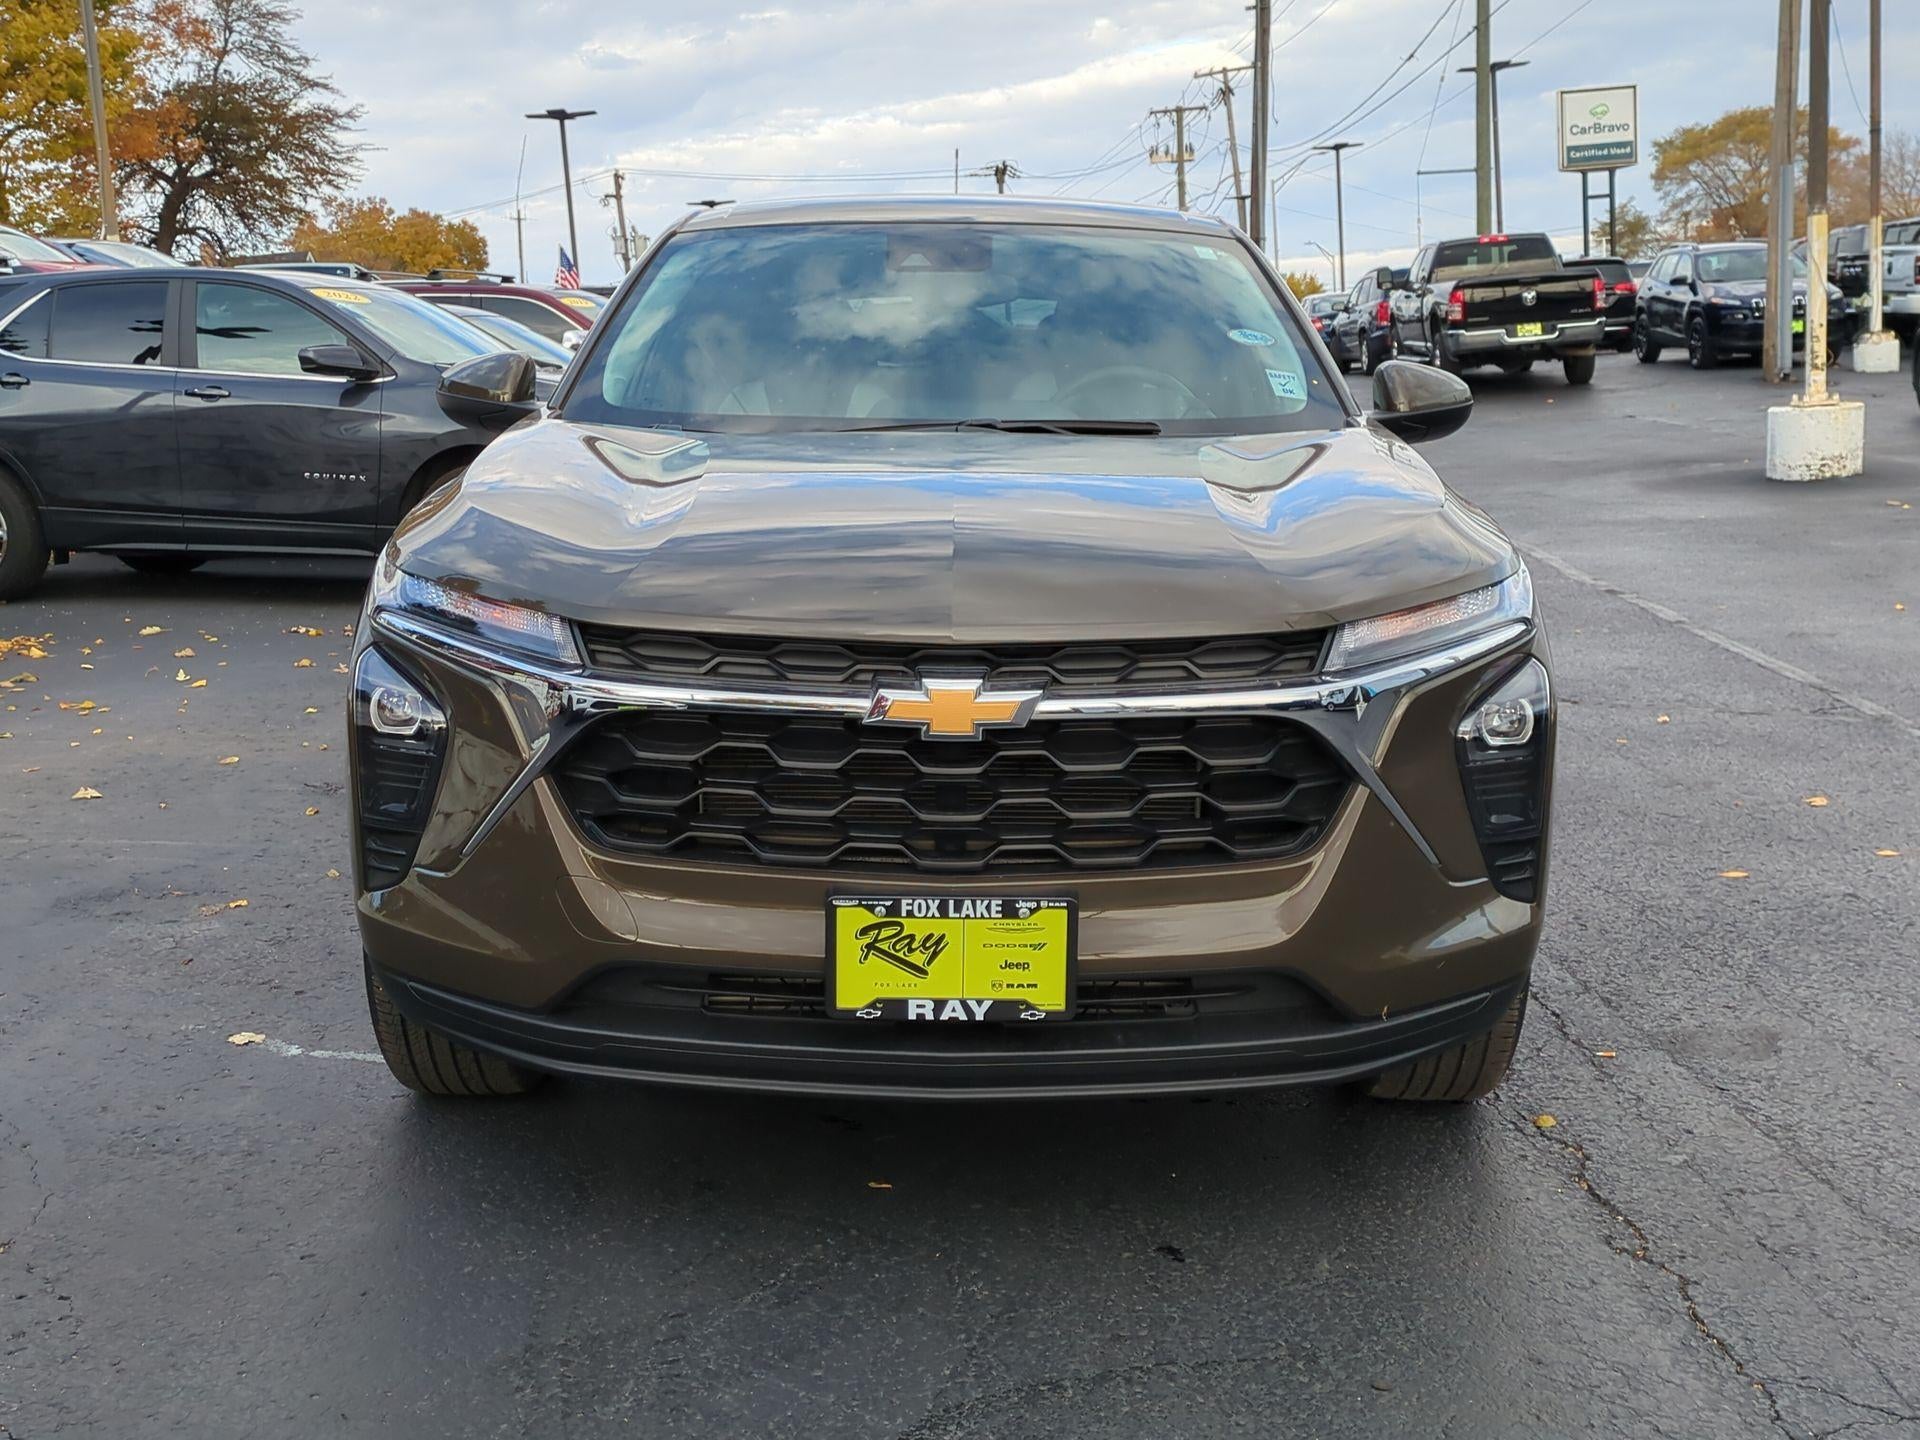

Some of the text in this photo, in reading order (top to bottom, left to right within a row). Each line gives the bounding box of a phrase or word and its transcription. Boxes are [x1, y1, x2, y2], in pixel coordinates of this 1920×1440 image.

[1569, 122, 1630, 135] CarBravo
[1570, 146, 1631, 158] Certified Used
[1268, 371, 1297, 382] SAFETY
[303, 471, 367, 483] EQUINOX
[901, 899, 1003, 919] FOX LAKE
[1015, 900, 1038, 909] Jeep
[854, 919, 950, 980] Ray
[999, 959, 1031, 972] Jeep
[908, 999, 994, 1021] RAY
